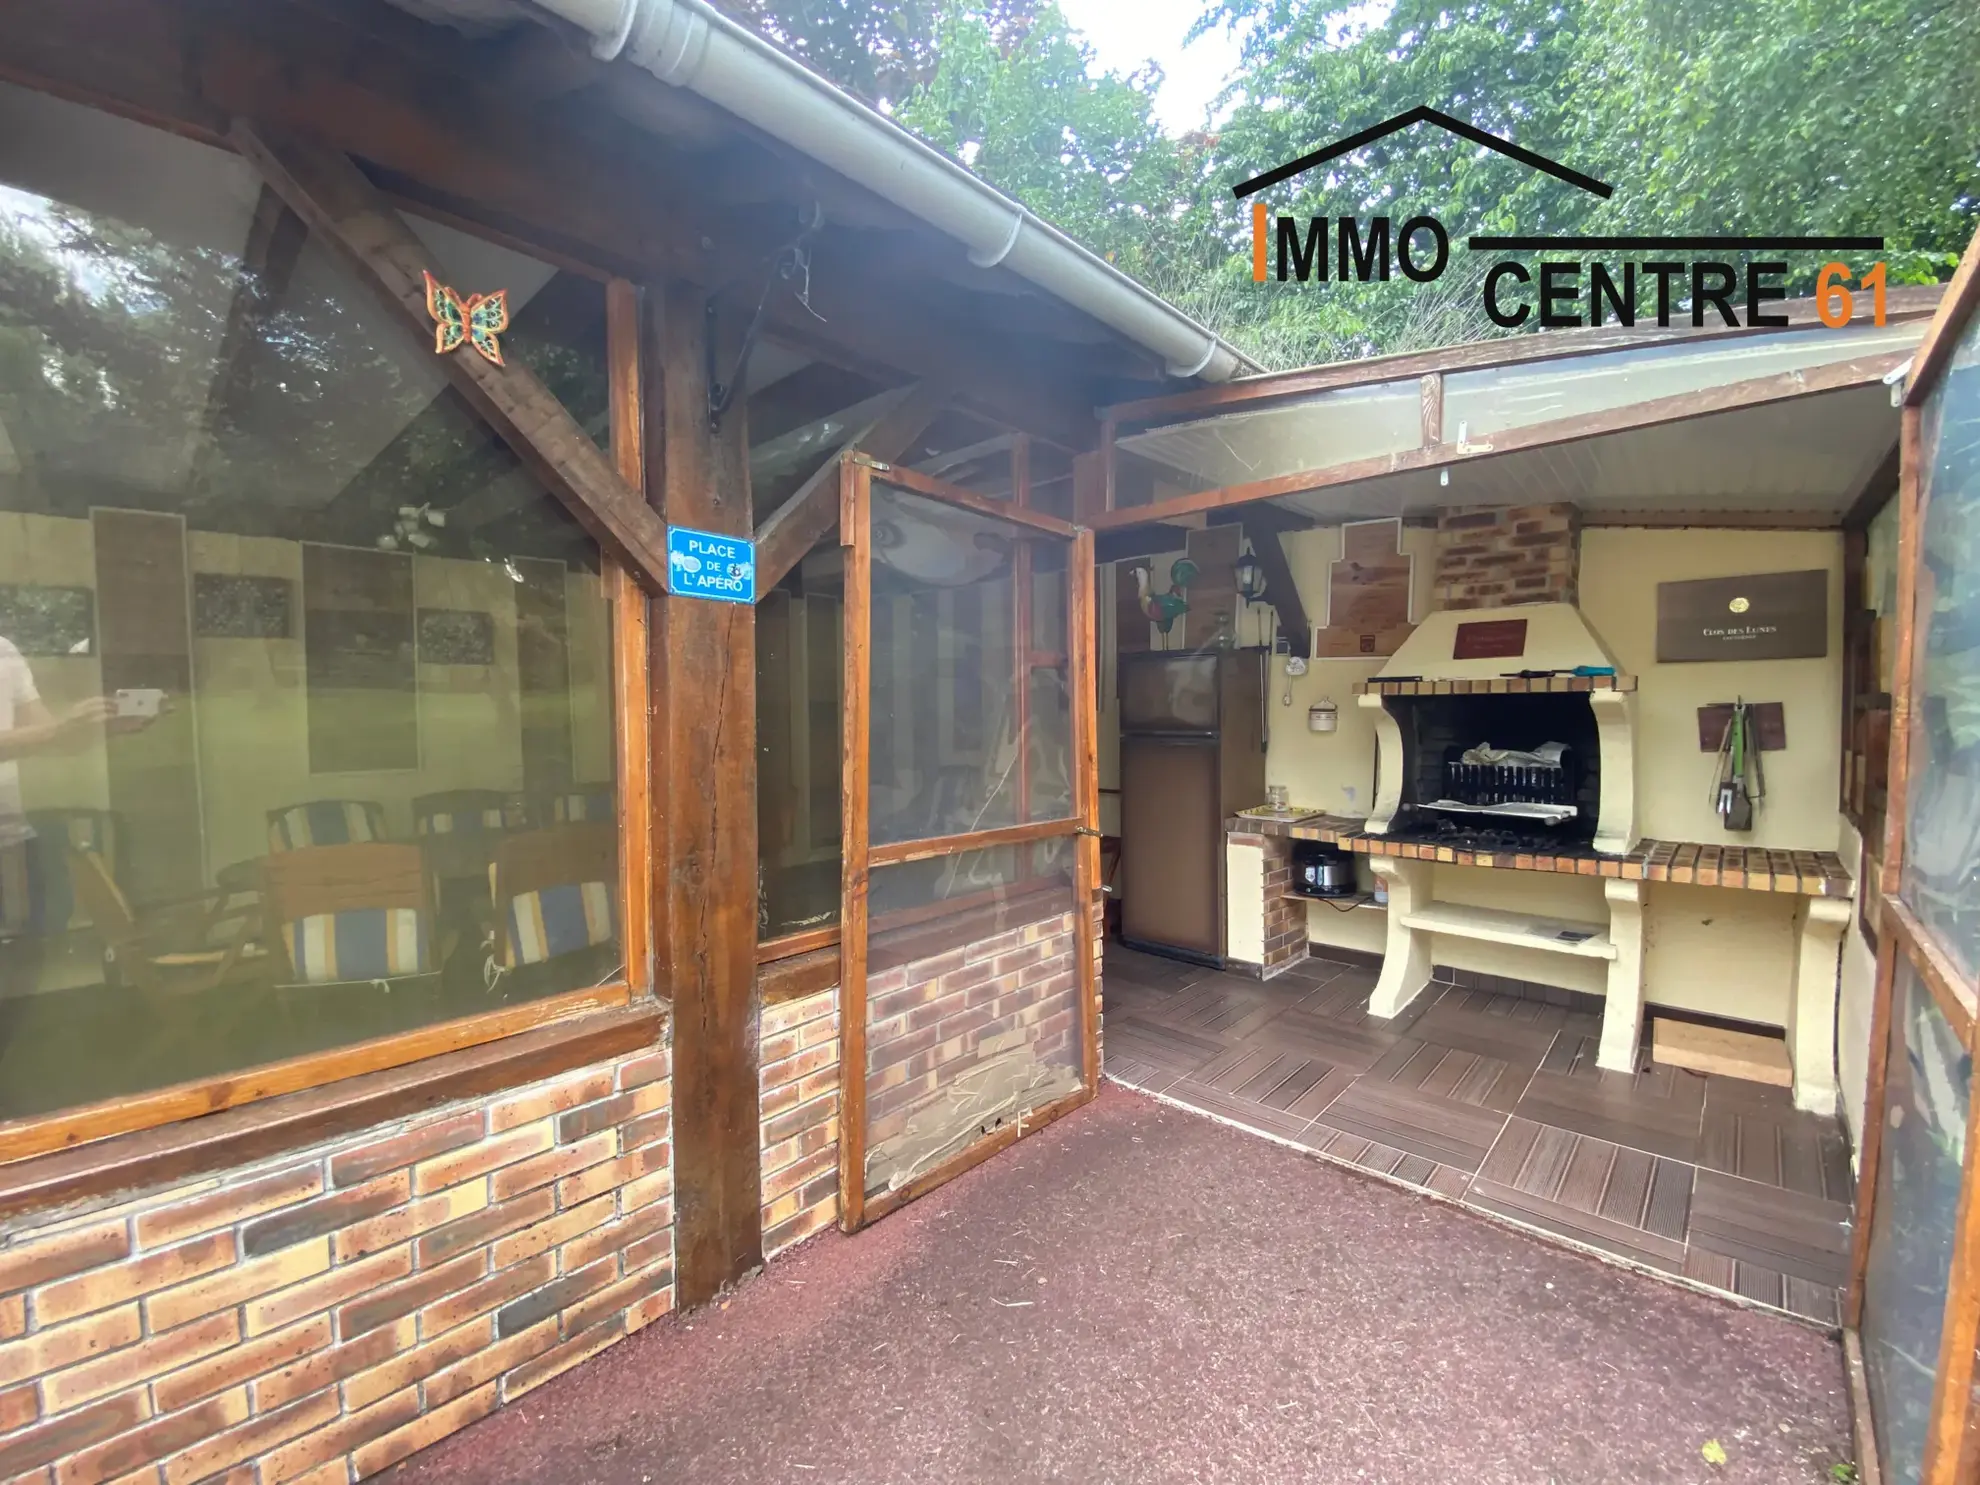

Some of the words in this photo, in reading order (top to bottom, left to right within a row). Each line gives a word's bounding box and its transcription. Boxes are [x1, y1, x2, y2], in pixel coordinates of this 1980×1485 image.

[688, 540, 736, 559] PLACE
[706, 561, 720, 572] DE
[683, 572, 743, 592] L'APÉRO
